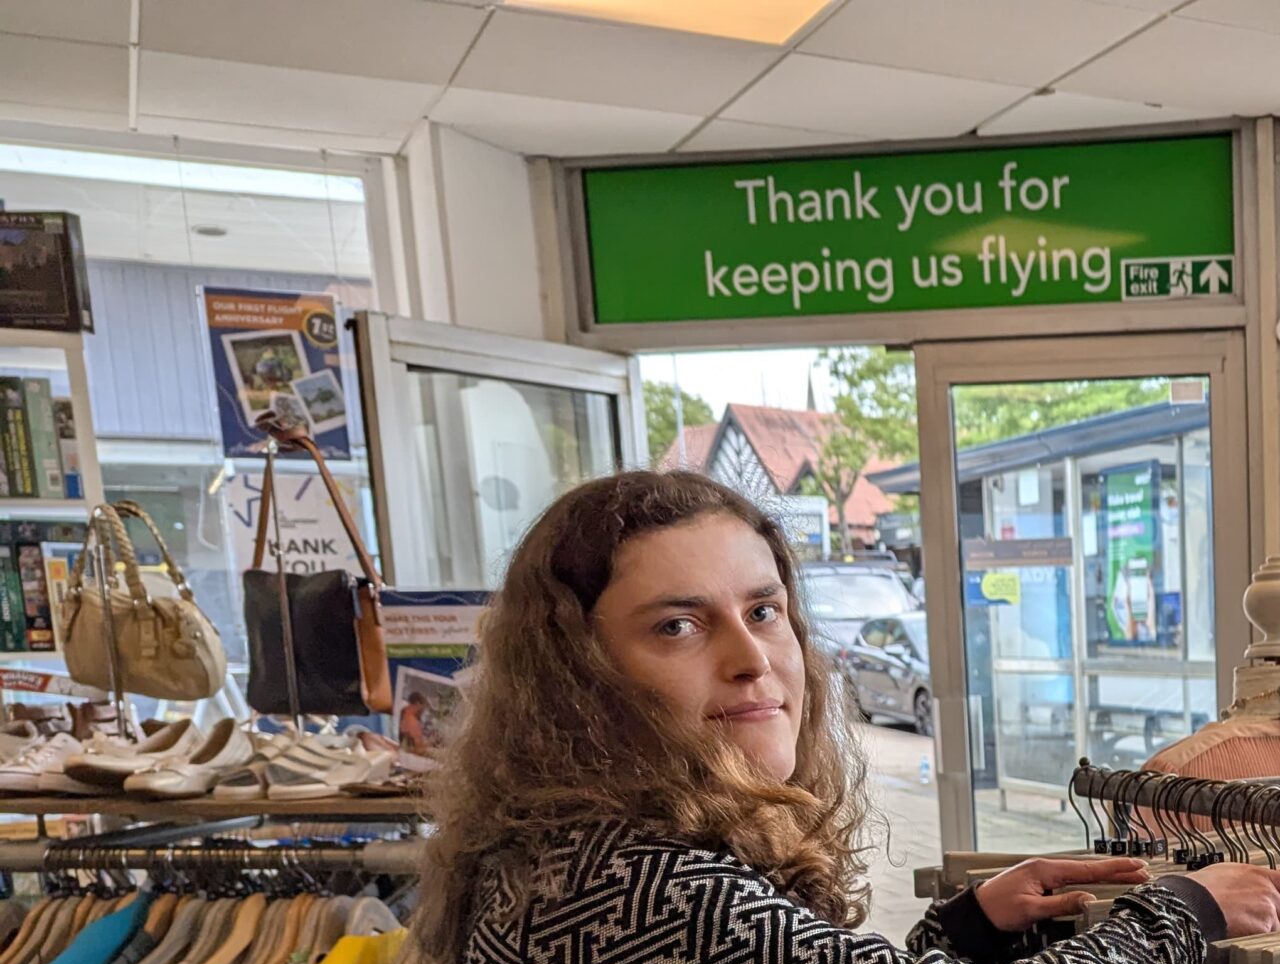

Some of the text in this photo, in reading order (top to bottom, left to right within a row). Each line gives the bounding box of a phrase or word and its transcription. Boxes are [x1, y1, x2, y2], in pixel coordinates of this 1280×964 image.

[735, 162, 1070, 232] Thank you for
[704, 234, 1112, 311] keeping us flying
[1129, 265, 1159, 281] Fire
[1130, 280, 1158, 295] exit
[212, 301, 303, 315] OUR FIRST FLIGHT
[214, 313, 284, 325] ANNIVERSARY
[252, 538, 339, 557] HANK
[284, 559, 326, 573] OU
[1157, 842, 1164, 851] S
